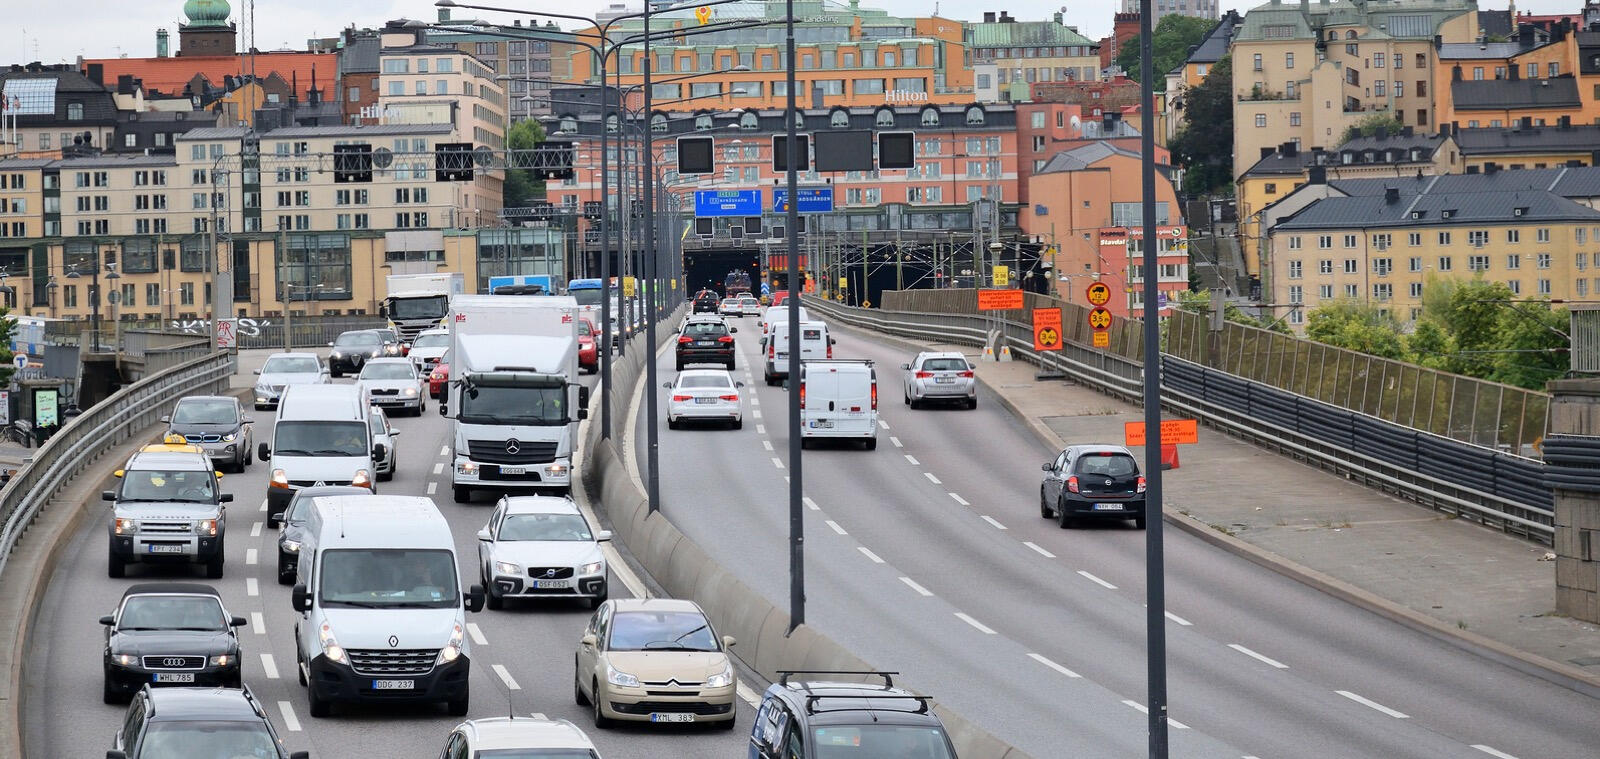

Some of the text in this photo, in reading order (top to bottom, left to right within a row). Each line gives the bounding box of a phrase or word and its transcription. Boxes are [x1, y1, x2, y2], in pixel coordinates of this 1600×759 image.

[885, 89, 928, 101] Hilton
[16, 357, 25, 367] T
[160, 674, 192, 682] WHL 785
[657, 714, 693, 722] XML 383
